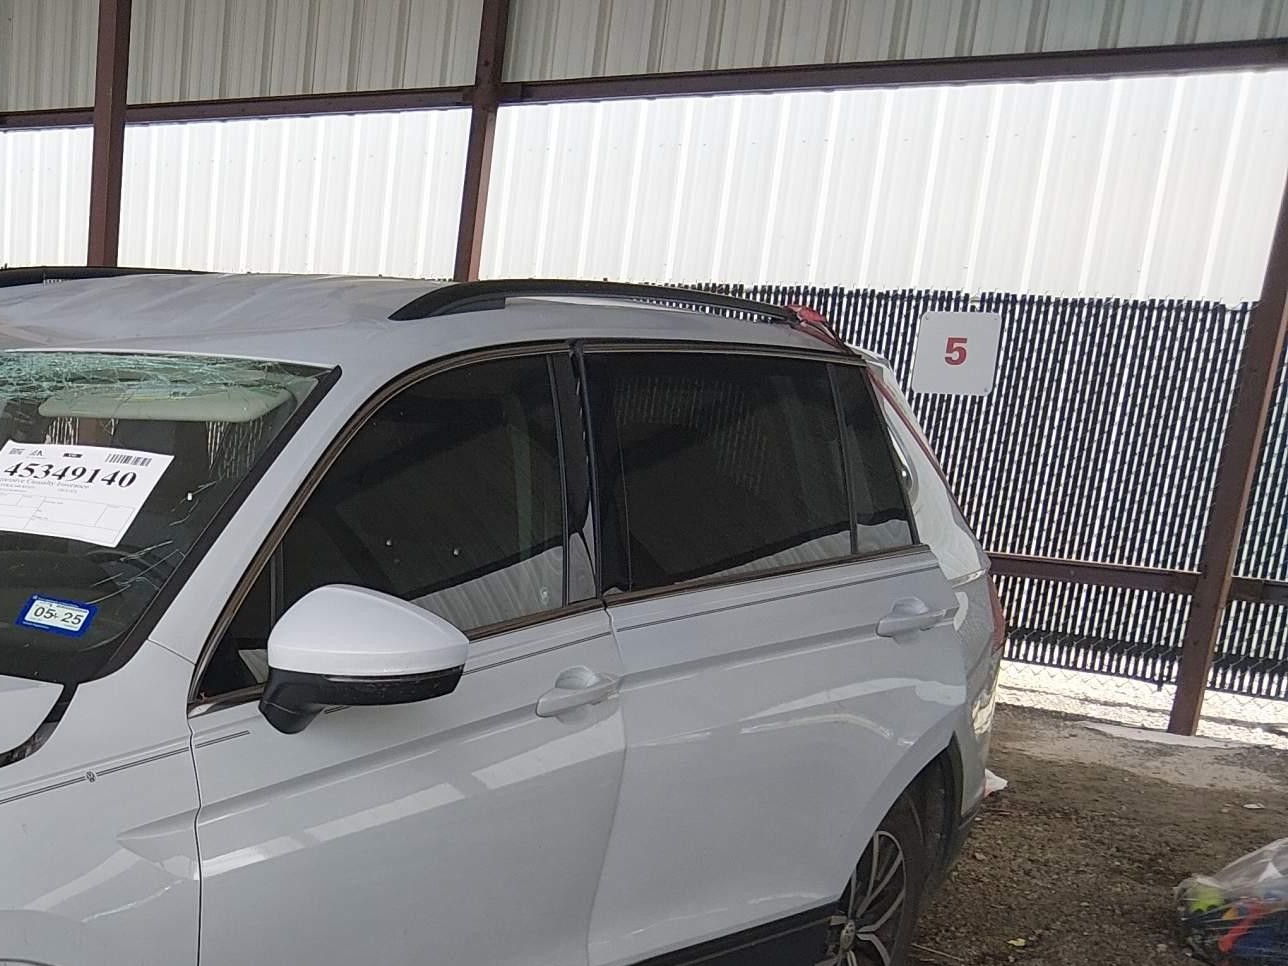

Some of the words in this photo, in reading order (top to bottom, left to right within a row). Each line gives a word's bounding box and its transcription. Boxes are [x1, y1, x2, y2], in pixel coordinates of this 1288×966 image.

[944, 336, 969, 367] 5
[4, 462, 138, 488] 45349140
[34, 606, 57, 620] 05
[61, 612, 85, 626] 25
